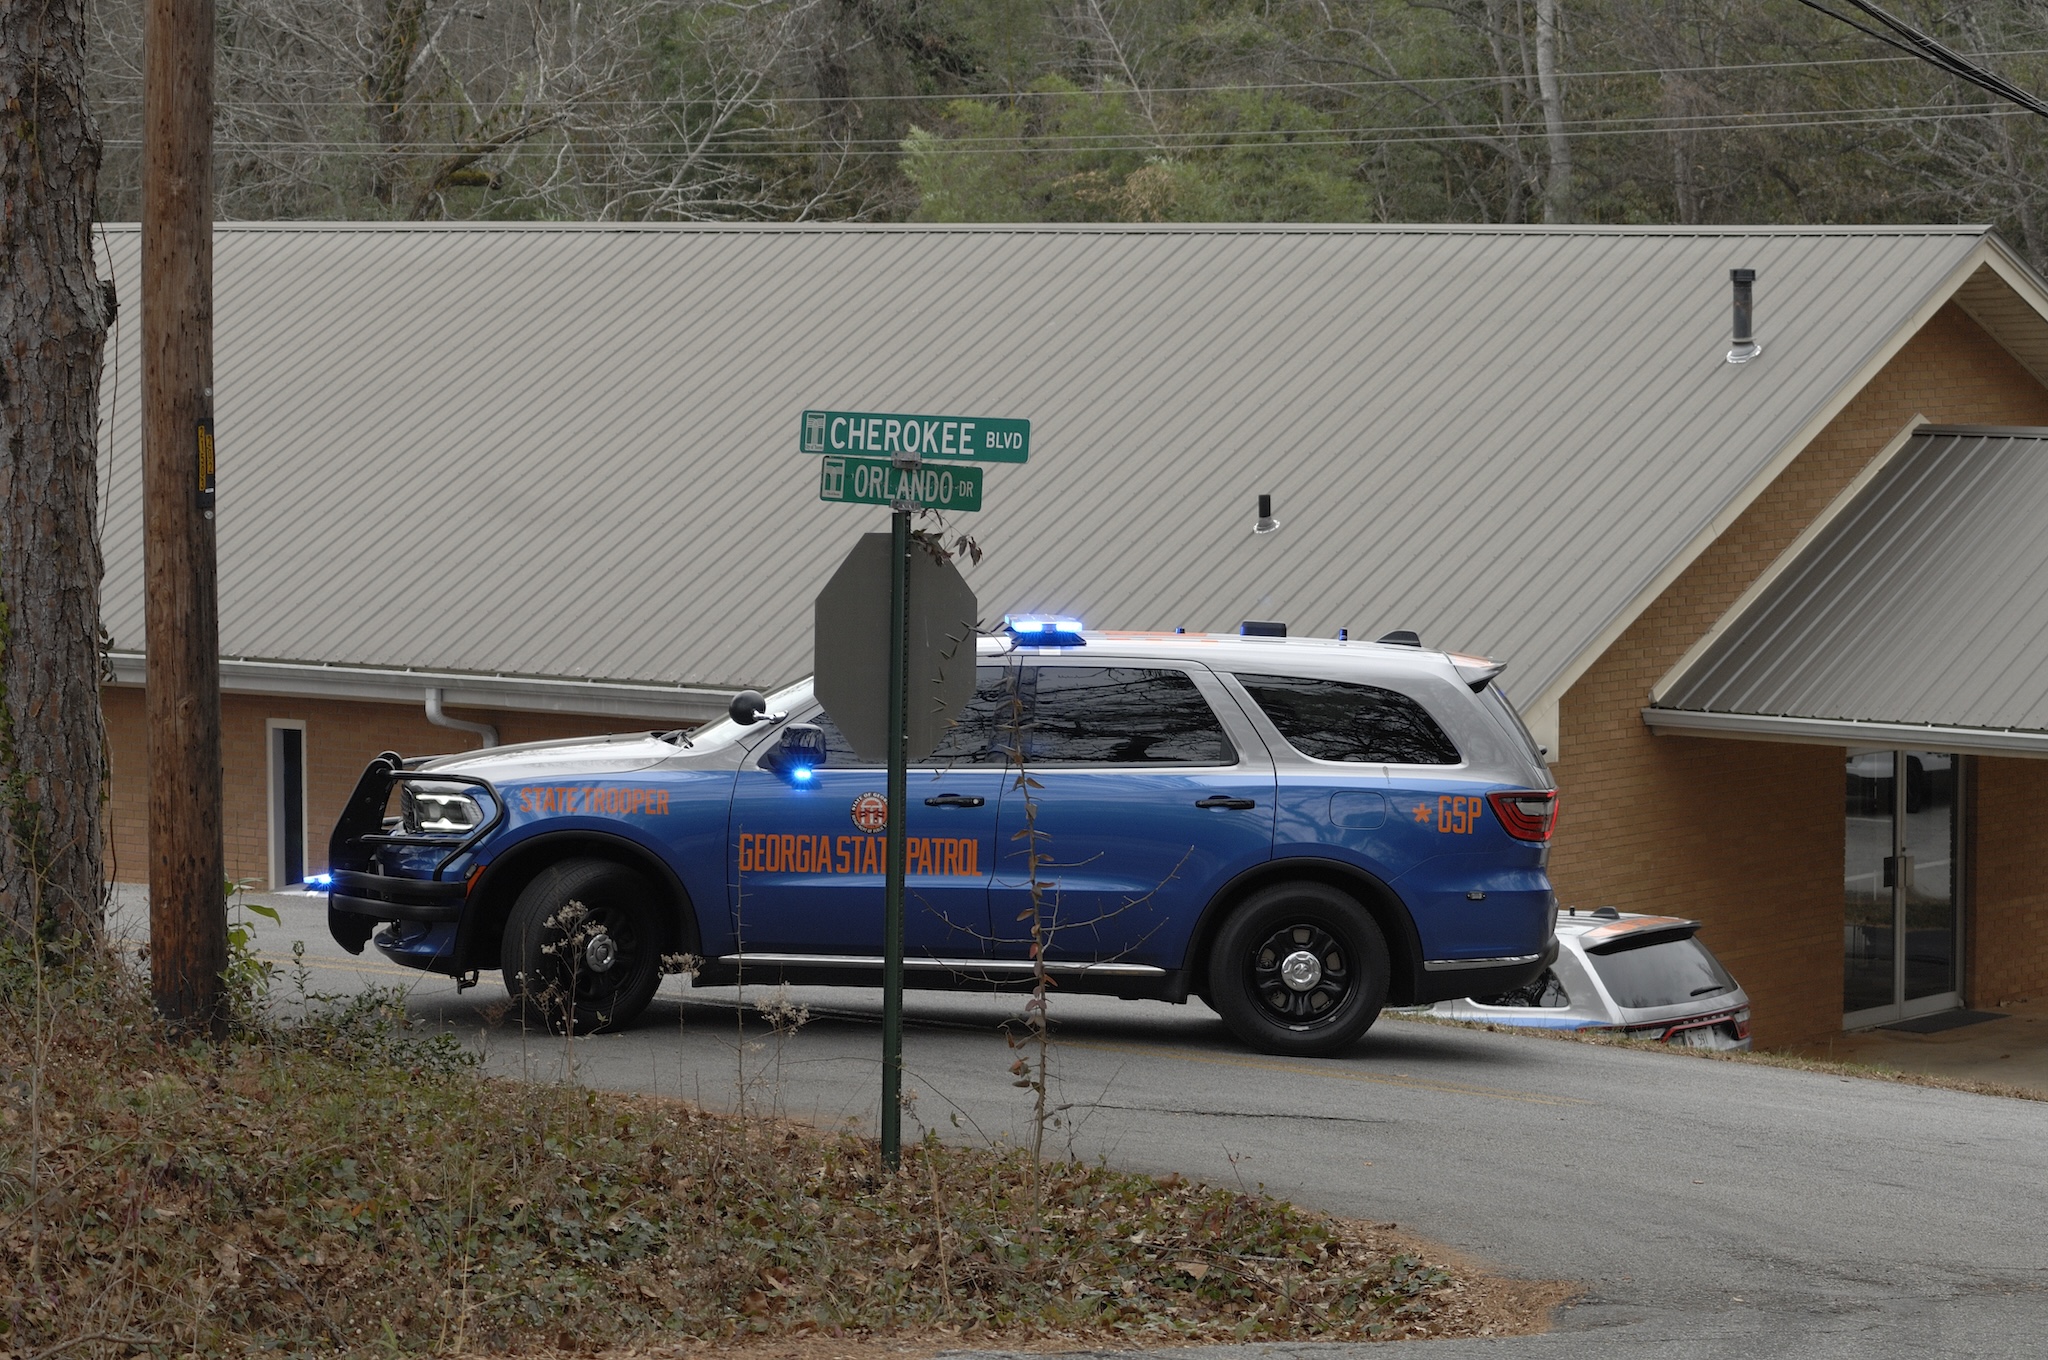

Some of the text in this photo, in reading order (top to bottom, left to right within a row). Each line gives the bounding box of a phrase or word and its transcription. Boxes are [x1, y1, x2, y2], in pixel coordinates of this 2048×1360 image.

[830, 417, 1023, 455] CHEROKEE BLVD
[854, 464, 974, 504] ORLANDO DR
[520, 787, 670, 815] STATE TROOPER
[1437, 795, 1483, 835] GSP
[739, 833, 983, 876] GEORGIA STAT PATROL
